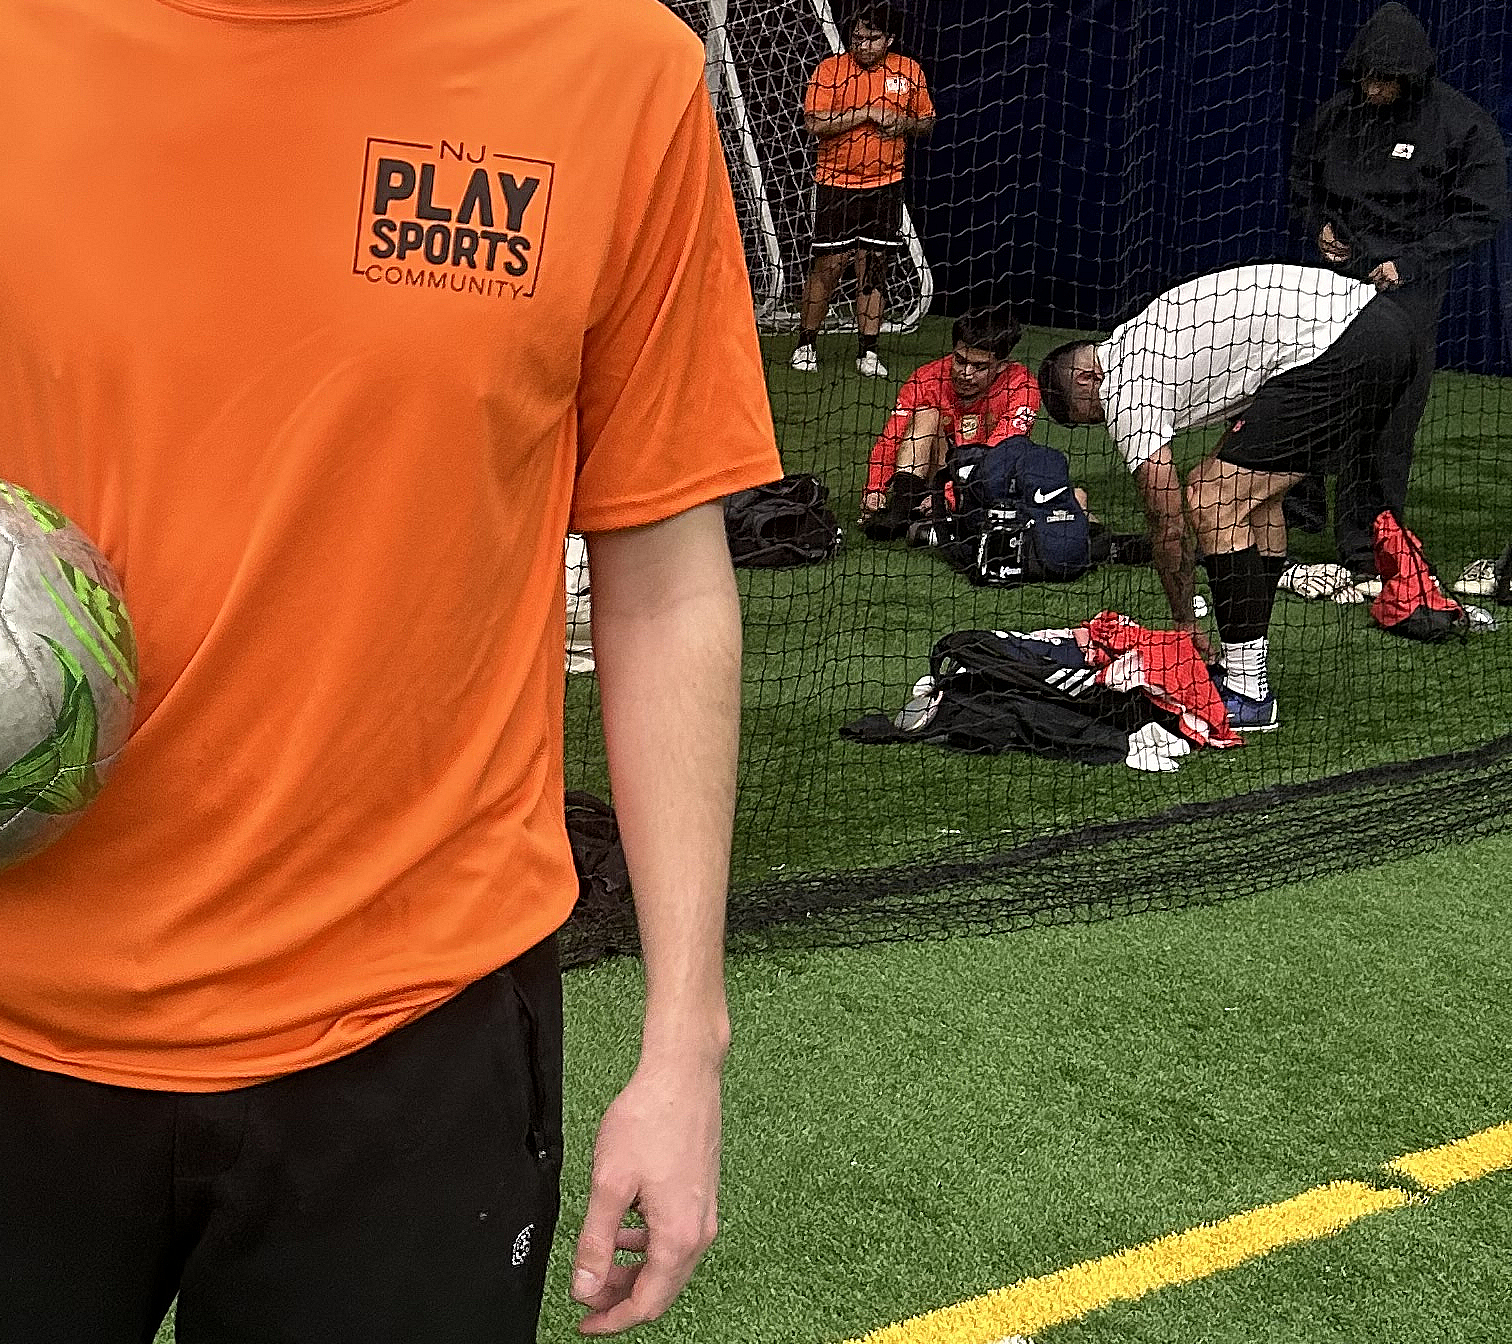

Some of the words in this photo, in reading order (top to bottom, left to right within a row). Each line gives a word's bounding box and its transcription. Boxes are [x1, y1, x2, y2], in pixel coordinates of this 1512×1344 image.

[439, 139, 486, 163] NJ
[372, 157, 540, 233] PLAY
[369, 218, 531, 277] SPORTS
[364, 264, 524, 301] COMMUNITY
